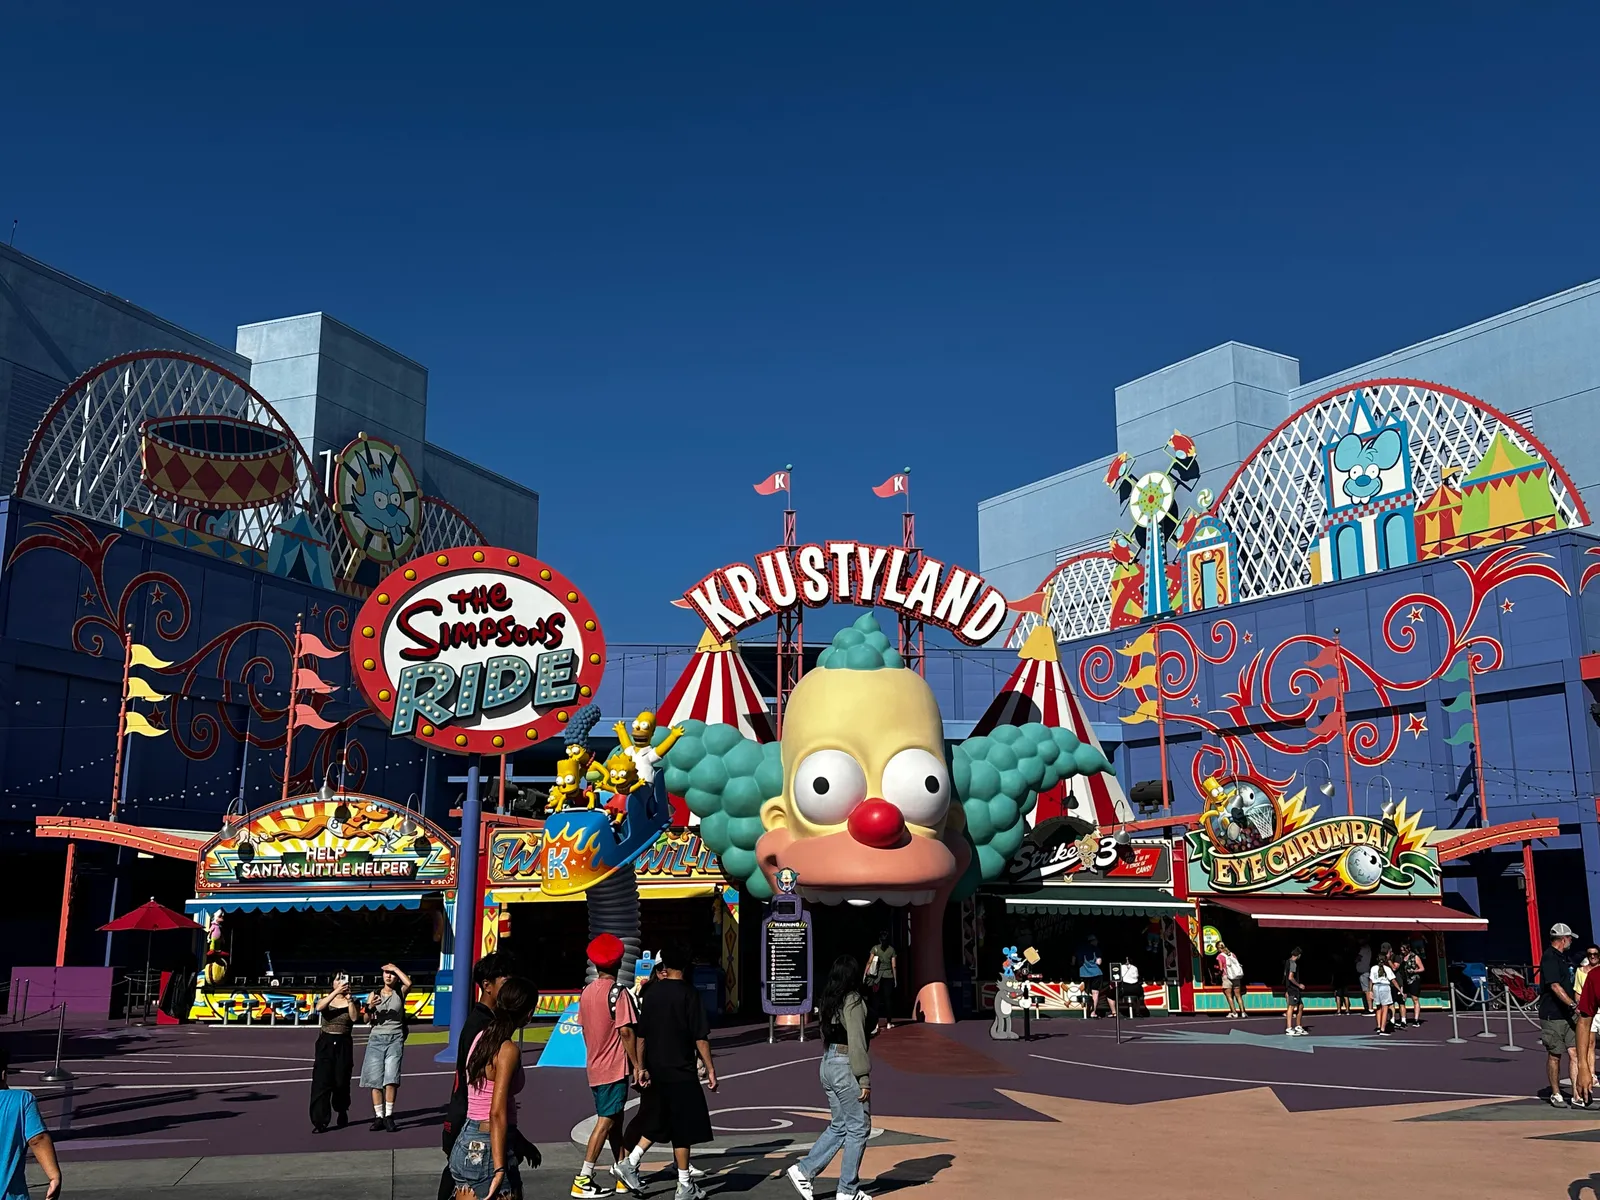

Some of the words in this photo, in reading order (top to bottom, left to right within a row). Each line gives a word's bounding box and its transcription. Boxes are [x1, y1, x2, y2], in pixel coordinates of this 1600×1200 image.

[775, 473, 786, 489] K
[893, 475, 904, 492] K
[449, 582, 512, 614] THE
[686, 541, 1009, 645] KRUSTYLAND
[397, 598, 566, 660] SIMPSONS
[391, 648, 580, 737] RIDE
[241, 862, 300, 878] SANTA'S
[304, 862, 351, 876] LITTLE
[354, 861, 409, 877] HELPER
[306, 847, 346, 862] HELP
[547, 847, 569, 880] K
[1009, 842, 1079, 874] Strike
[1095, 837, 1117, 867] 3
[1214, 856, 1267, 887] EYE
[1266, 819, 1392, 876] CARUMBA!
